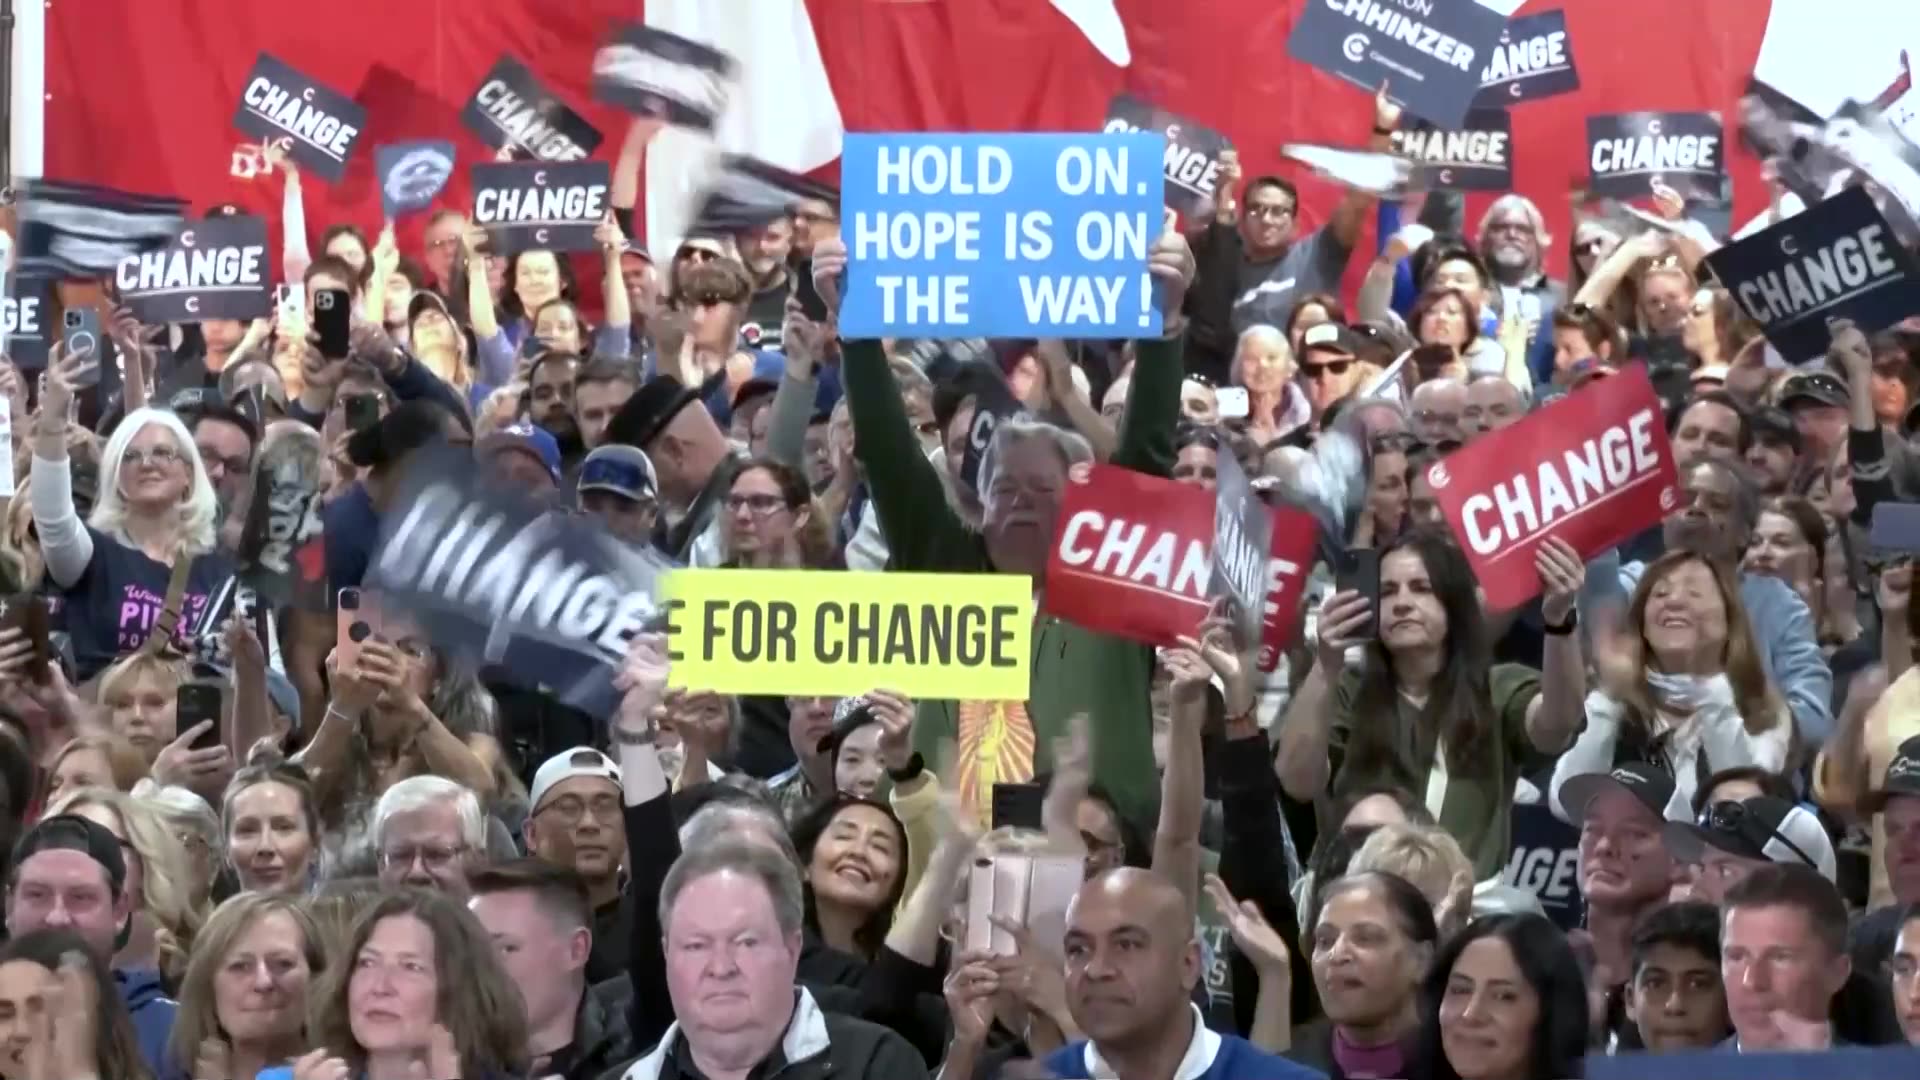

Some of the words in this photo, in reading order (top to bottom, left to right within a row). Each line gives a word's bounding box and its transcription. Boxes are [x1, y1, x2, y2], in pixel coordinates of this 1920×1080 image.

[1481, 31, 1566, 82] ANGE
[244, 76, 358, 155] CHANGE
[877, 145, 1013, 195] HOLD
[1056, 145, 1147, 196] ON.
[1592, 134, 1719, 172] CHANGE
[475, 185, 606, 222] CHANGE
[855, 211, 980, 261] HOPE
[1004, 210, 1053, 261] IS
[1076, 210, 1148, 261] ON
[116, 246, 263, 290] CHANGE
[1738, 224, 1896, 324] CHANGE
[876, 275, 969, 324] THE
[1018, 273, 1151, 328] WAY!
[1461, 409, 1659, 554] CHANGE
[1059, 510, 1298, 615] CHANE
[703, 600, 797, 662] FOR
[814, 601, 1019, 667] CHANGE
